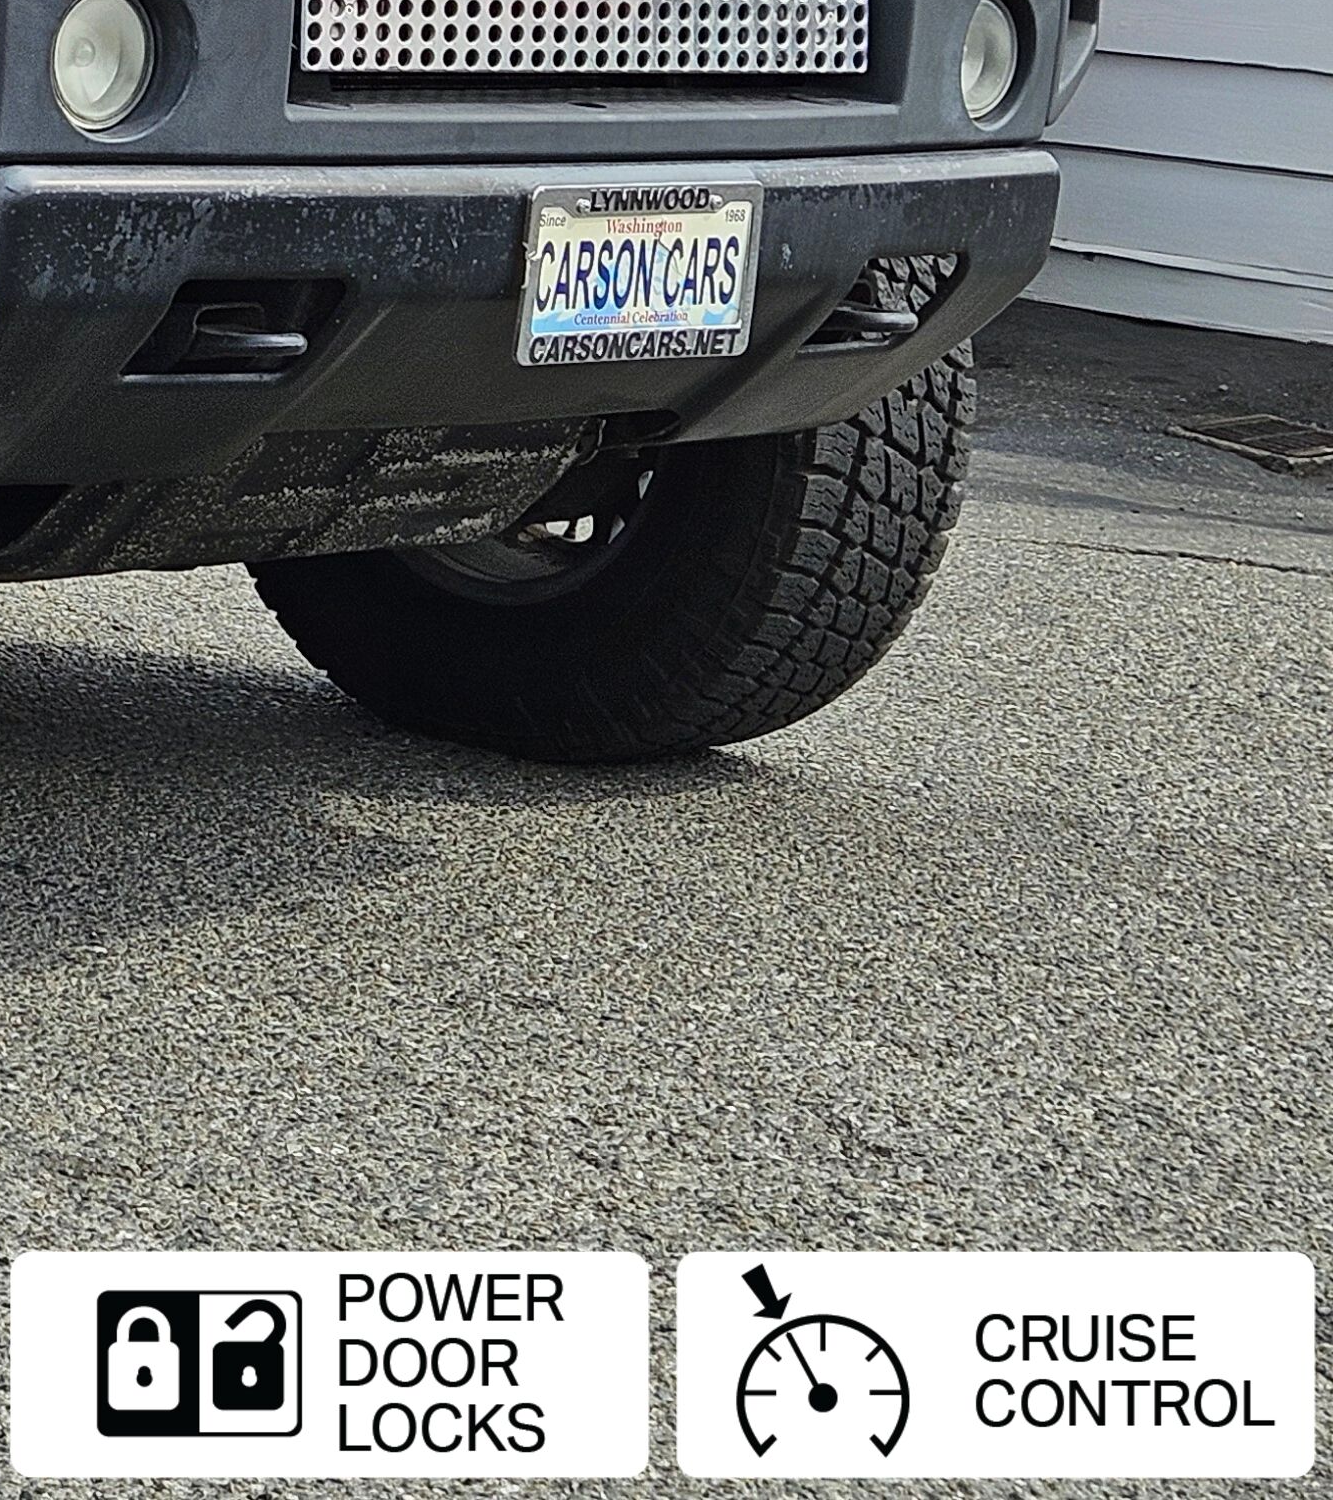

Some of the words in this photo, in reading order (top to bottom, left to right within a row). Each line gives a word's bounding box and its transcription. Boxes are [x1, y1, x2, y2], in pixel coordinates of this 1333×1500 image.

[589, 187, 711, 213] LYNNWOOD
[539, 212, 567, 229] Since
[605, 218, 683, 237] Washington
[535, 238, 659, 313] CARSON
[662, 235, 740, 306] CARS
[574, 312, 630, 326] Centennial
[632, 310, 689, 325] Celebration
[528, 328, 741, 364] CARSONCARS.NET
